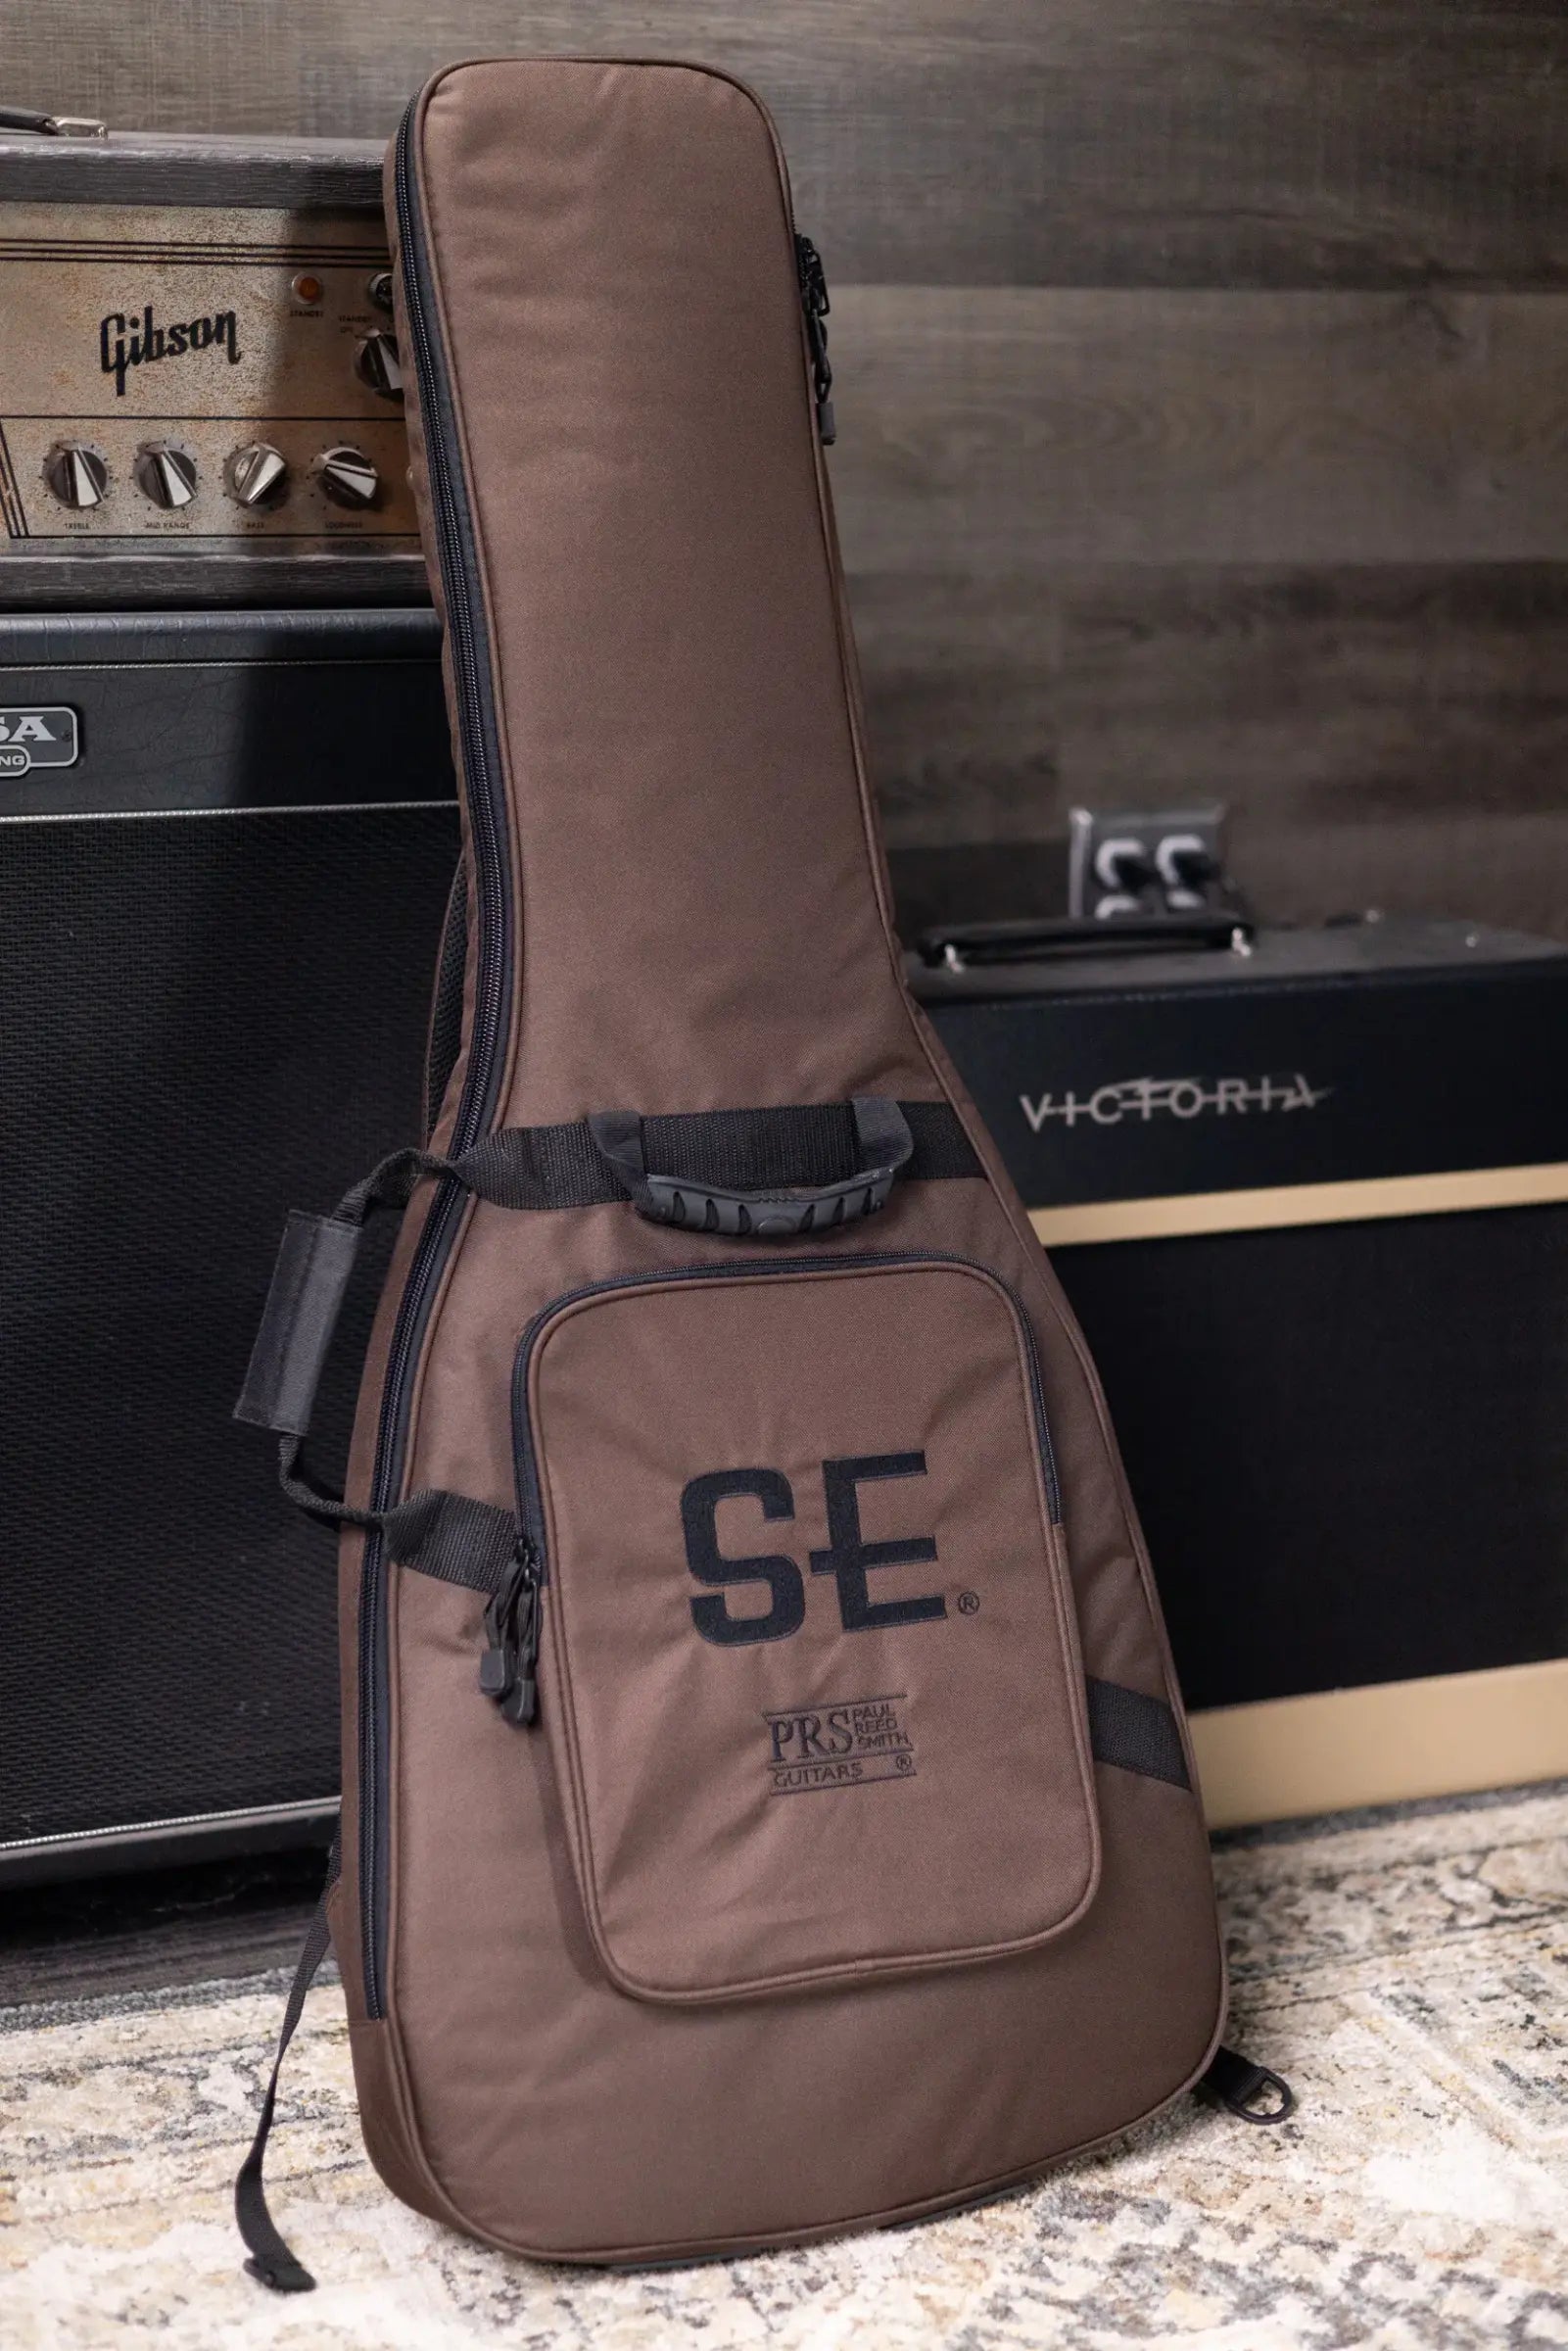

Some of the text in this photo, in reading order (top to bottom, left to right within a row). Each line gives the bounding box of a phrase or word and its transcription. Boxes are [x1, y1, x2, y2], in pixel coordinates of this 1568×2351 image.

[100, 305, 244, 397] Gibson
[1020, 1074, 1318, 1132] VICTORIA
[852, 1703, 894, 1721] PAUL
[770, 1709, 853, 1762] PRS
[854, 1717, 898, 1735] REED
[858, 1731, 910, 1751] SMITH
[774, 1762, 864, 1788] GUITARS
